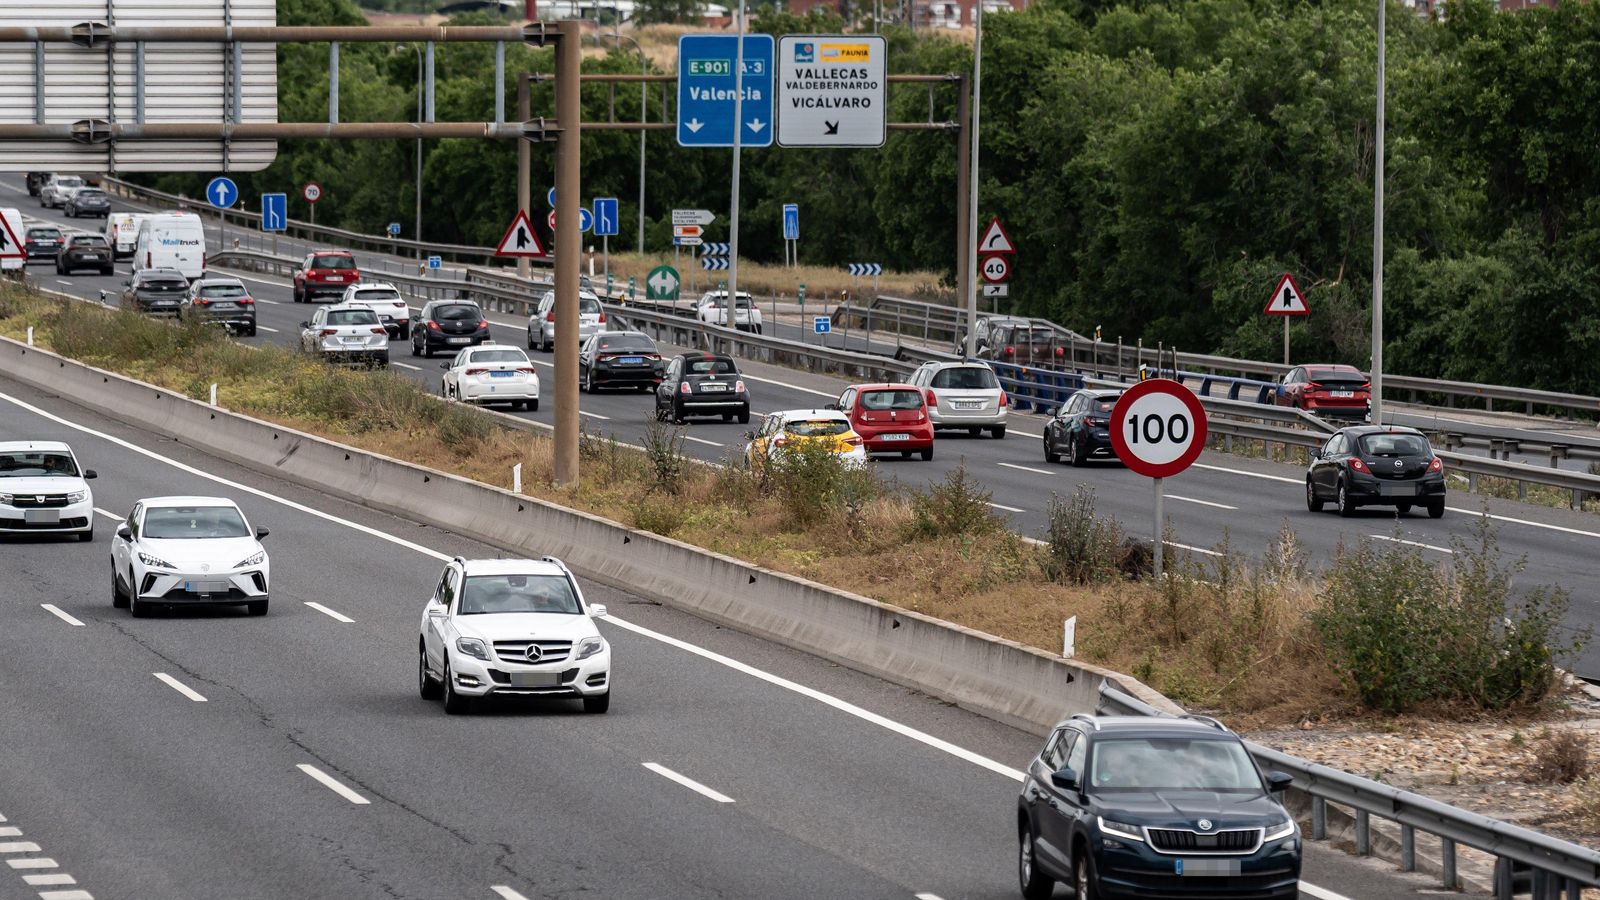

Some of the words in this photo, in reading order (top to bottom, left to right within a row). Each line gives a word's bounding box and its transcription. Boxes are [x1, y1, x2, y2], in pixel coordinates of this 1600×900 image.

[690, 62, 728, 73] E-901
[740, 62, 762, 73] A-3
[795, 68, 868, 79] VALLECAS
[785, 81, 878, 90] VALDEBERNARDO
[689, 86, 761, 100] Valencia
[792, 95, 871, 108] VICÁLVARO
[986, 264, 1004, 274] 40
[1128, 413, 1189, 444] 100
